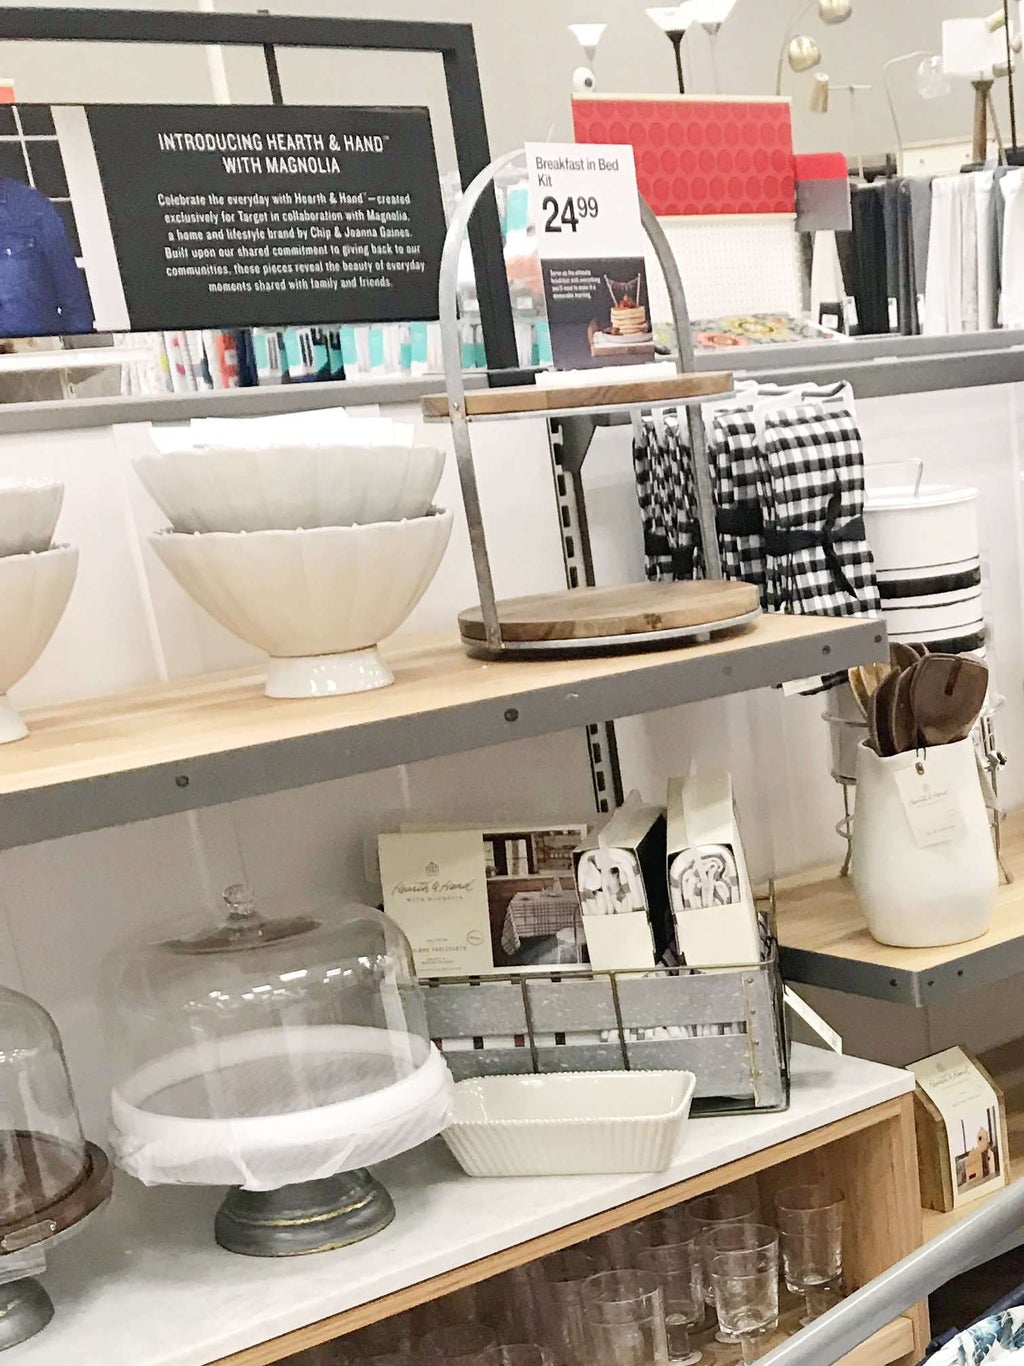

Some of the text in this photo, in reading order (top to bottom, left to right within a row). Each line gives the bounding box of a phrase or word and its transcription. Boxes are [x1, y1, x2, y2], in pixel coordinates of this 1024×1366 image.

[158, 132, 262, 151] INTRODUCING
[266, 133, 324, 151] HEARTH
[329, 133, 341, 151] &
[222, 156, 341, 173] WITH MAGNOLIA
[535, 156, 619, 171] Breakfast in Bed
[537, 173, 553, 187] Kit
[157, 193, 206, 206] Celebrate
[208, 192, 225, 206] the
[227, 193, 269, 207] everyday
[271, 192, 293, 205] with
[294, 192, 327, 205] Hearth
[329, 191, 338, 205] &
[164, 210, 219, 225] exclusively
[221, 210, 235, 223] for
[237, 210, 268, 225] Target
[270, 211, 280, 222] in
[281, 209, 343, 222] collaboration
[344, 209, 365, 222] with
[168, 231, 175, 241] a
[176, 228, 203, 241] home
[206, 228, 224, 240] and
[226, 226, 265, 242] lifestyle
[267, 226, 294, 240] brand
[296, 227, 308, 240] by
[310, 226, 332, 240] Chip
[334, 225, 343, 239] &
[344, 226, 378, 239] Joanna
[164, 243, 421, 260] Built upon our shared commitment to giving back to our
[233, 262, 261, 276] these
[262, 262, 293, 277] pieces
[295, 260, 324, 273] reveal
[325, 260, 340, 272] the
[342, 260, 373, 274] beauty
[375, 259, 384, 272] of
[386, 259, 426, 273] everyday
[208, 281, 252, 292] moments
[254, 278, 286, 292] shared
[288, 278, 308, 291] with
[310, 277, 338, 291] family
[340, 276, 357, 288] and
